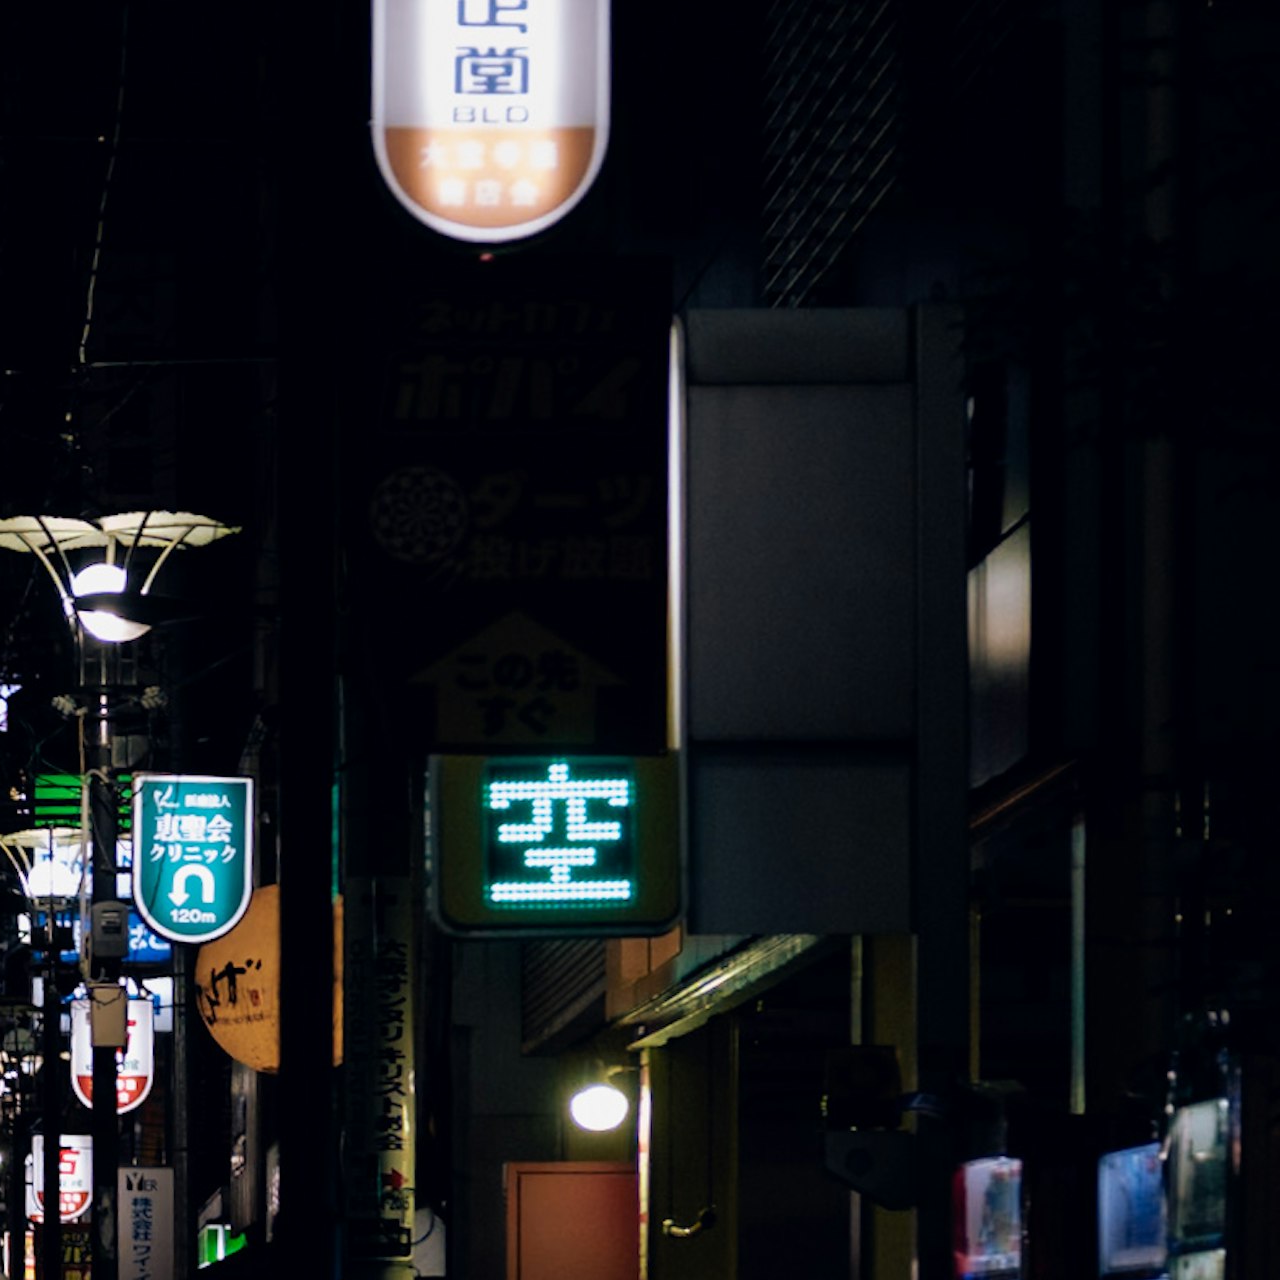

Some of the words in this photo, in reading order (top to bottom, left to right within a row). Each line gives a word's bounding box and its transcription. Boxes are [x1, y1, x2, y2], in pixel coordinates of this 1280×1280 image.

[453, 106, 529, 123] BLD
[393, 354, 642, 421] ポパイ
[470, 468, 654, 530] ダーツ
[456, 653, 578, 691] この先
[480, 699, 554, 736] すぐ
[490, 763, 630, 902] 空
[150, 843, 237, 864] クリニック
[169, 908, 217, 924] 120m
